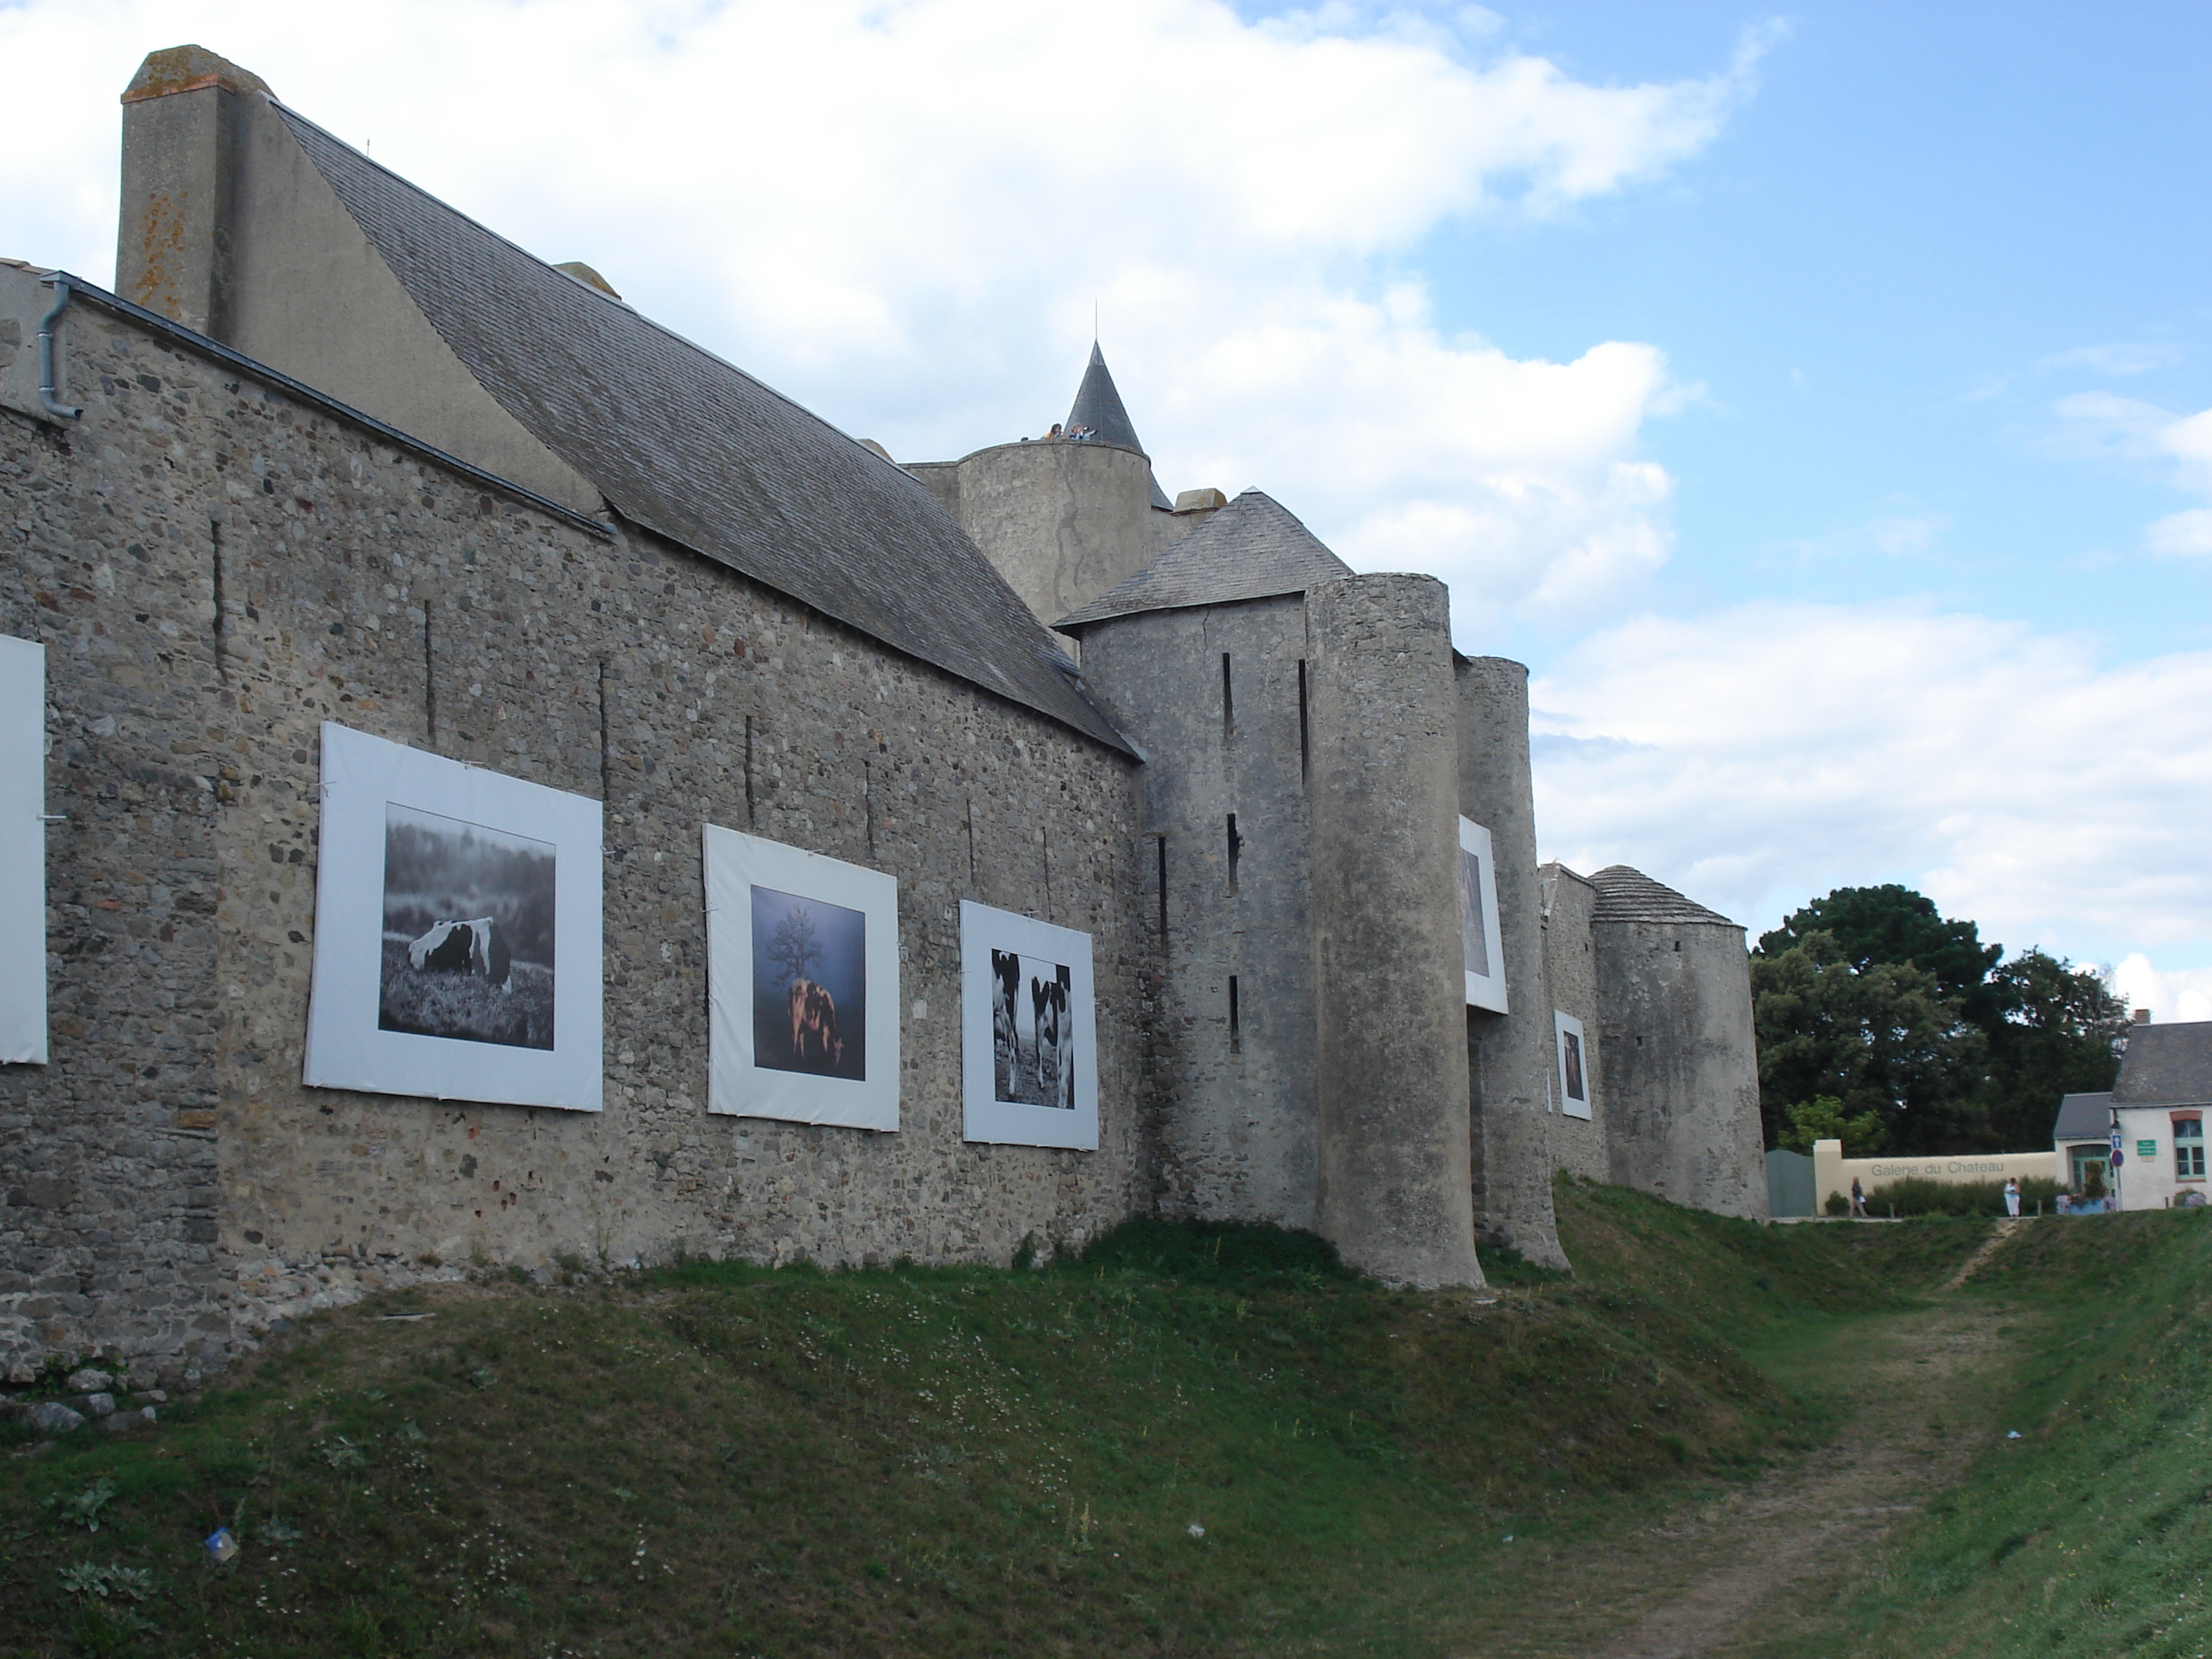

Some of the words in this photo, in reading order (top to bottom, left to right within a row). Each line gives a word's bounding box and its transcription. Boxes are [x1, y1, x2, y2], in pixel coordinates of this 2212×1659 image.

[1871, 1164, 1918, 1177] Galerie
[1925, 1163, 1941, 1174] du
[1948, 1161, 2005, 1174] Chateau
